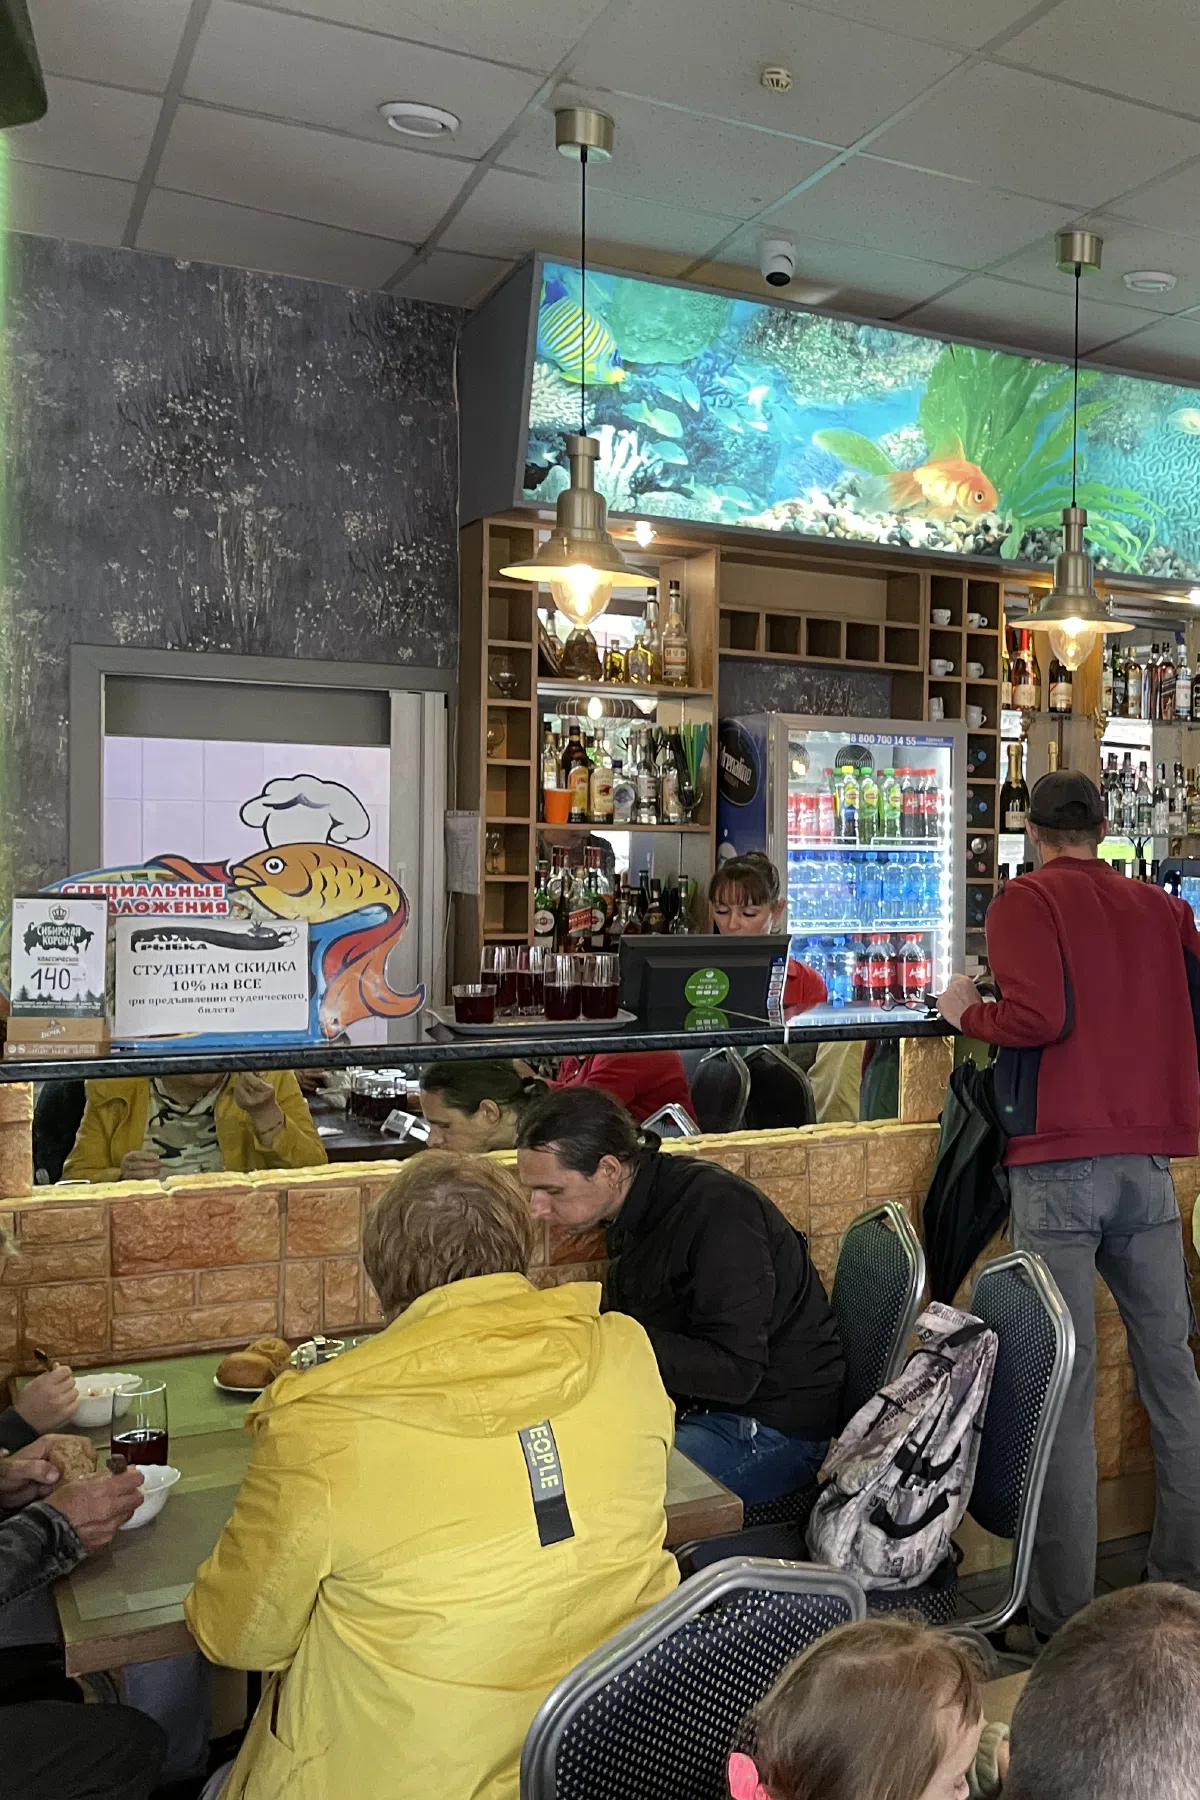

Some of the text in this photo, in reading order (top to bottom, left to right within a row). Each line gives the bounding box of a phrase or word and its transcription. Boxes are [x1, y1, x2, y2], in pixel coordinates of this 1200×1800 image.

[850, 734, 857, 743] 8
[858, 734, 875, 743] 800
[877, 735, 892, 744] 700
[894, 736, 904, 745] 14
[906, 737, 916, 745] 55
[62, 884, 224, 899] СПЕЦИАЛЬНЫЕ
[109, 902, 228, 914] ДЛОЖЕНИЯ
[37, 924, 81, 938] СИБИРСКАЯ
[42, 935, 75, 947] КОРОНА
[133, 961, 296, 977] СТУДЕНТАМ СКИДКА
[31, 967, 71, 990] 140
[172, 978, 262, 992] 10% на ВСЕ
[148, 995, 227, 1006] предъявлении
[197, 1005, 236, 1015] билета
[529, 1421, 559, 1489] EOPLE
